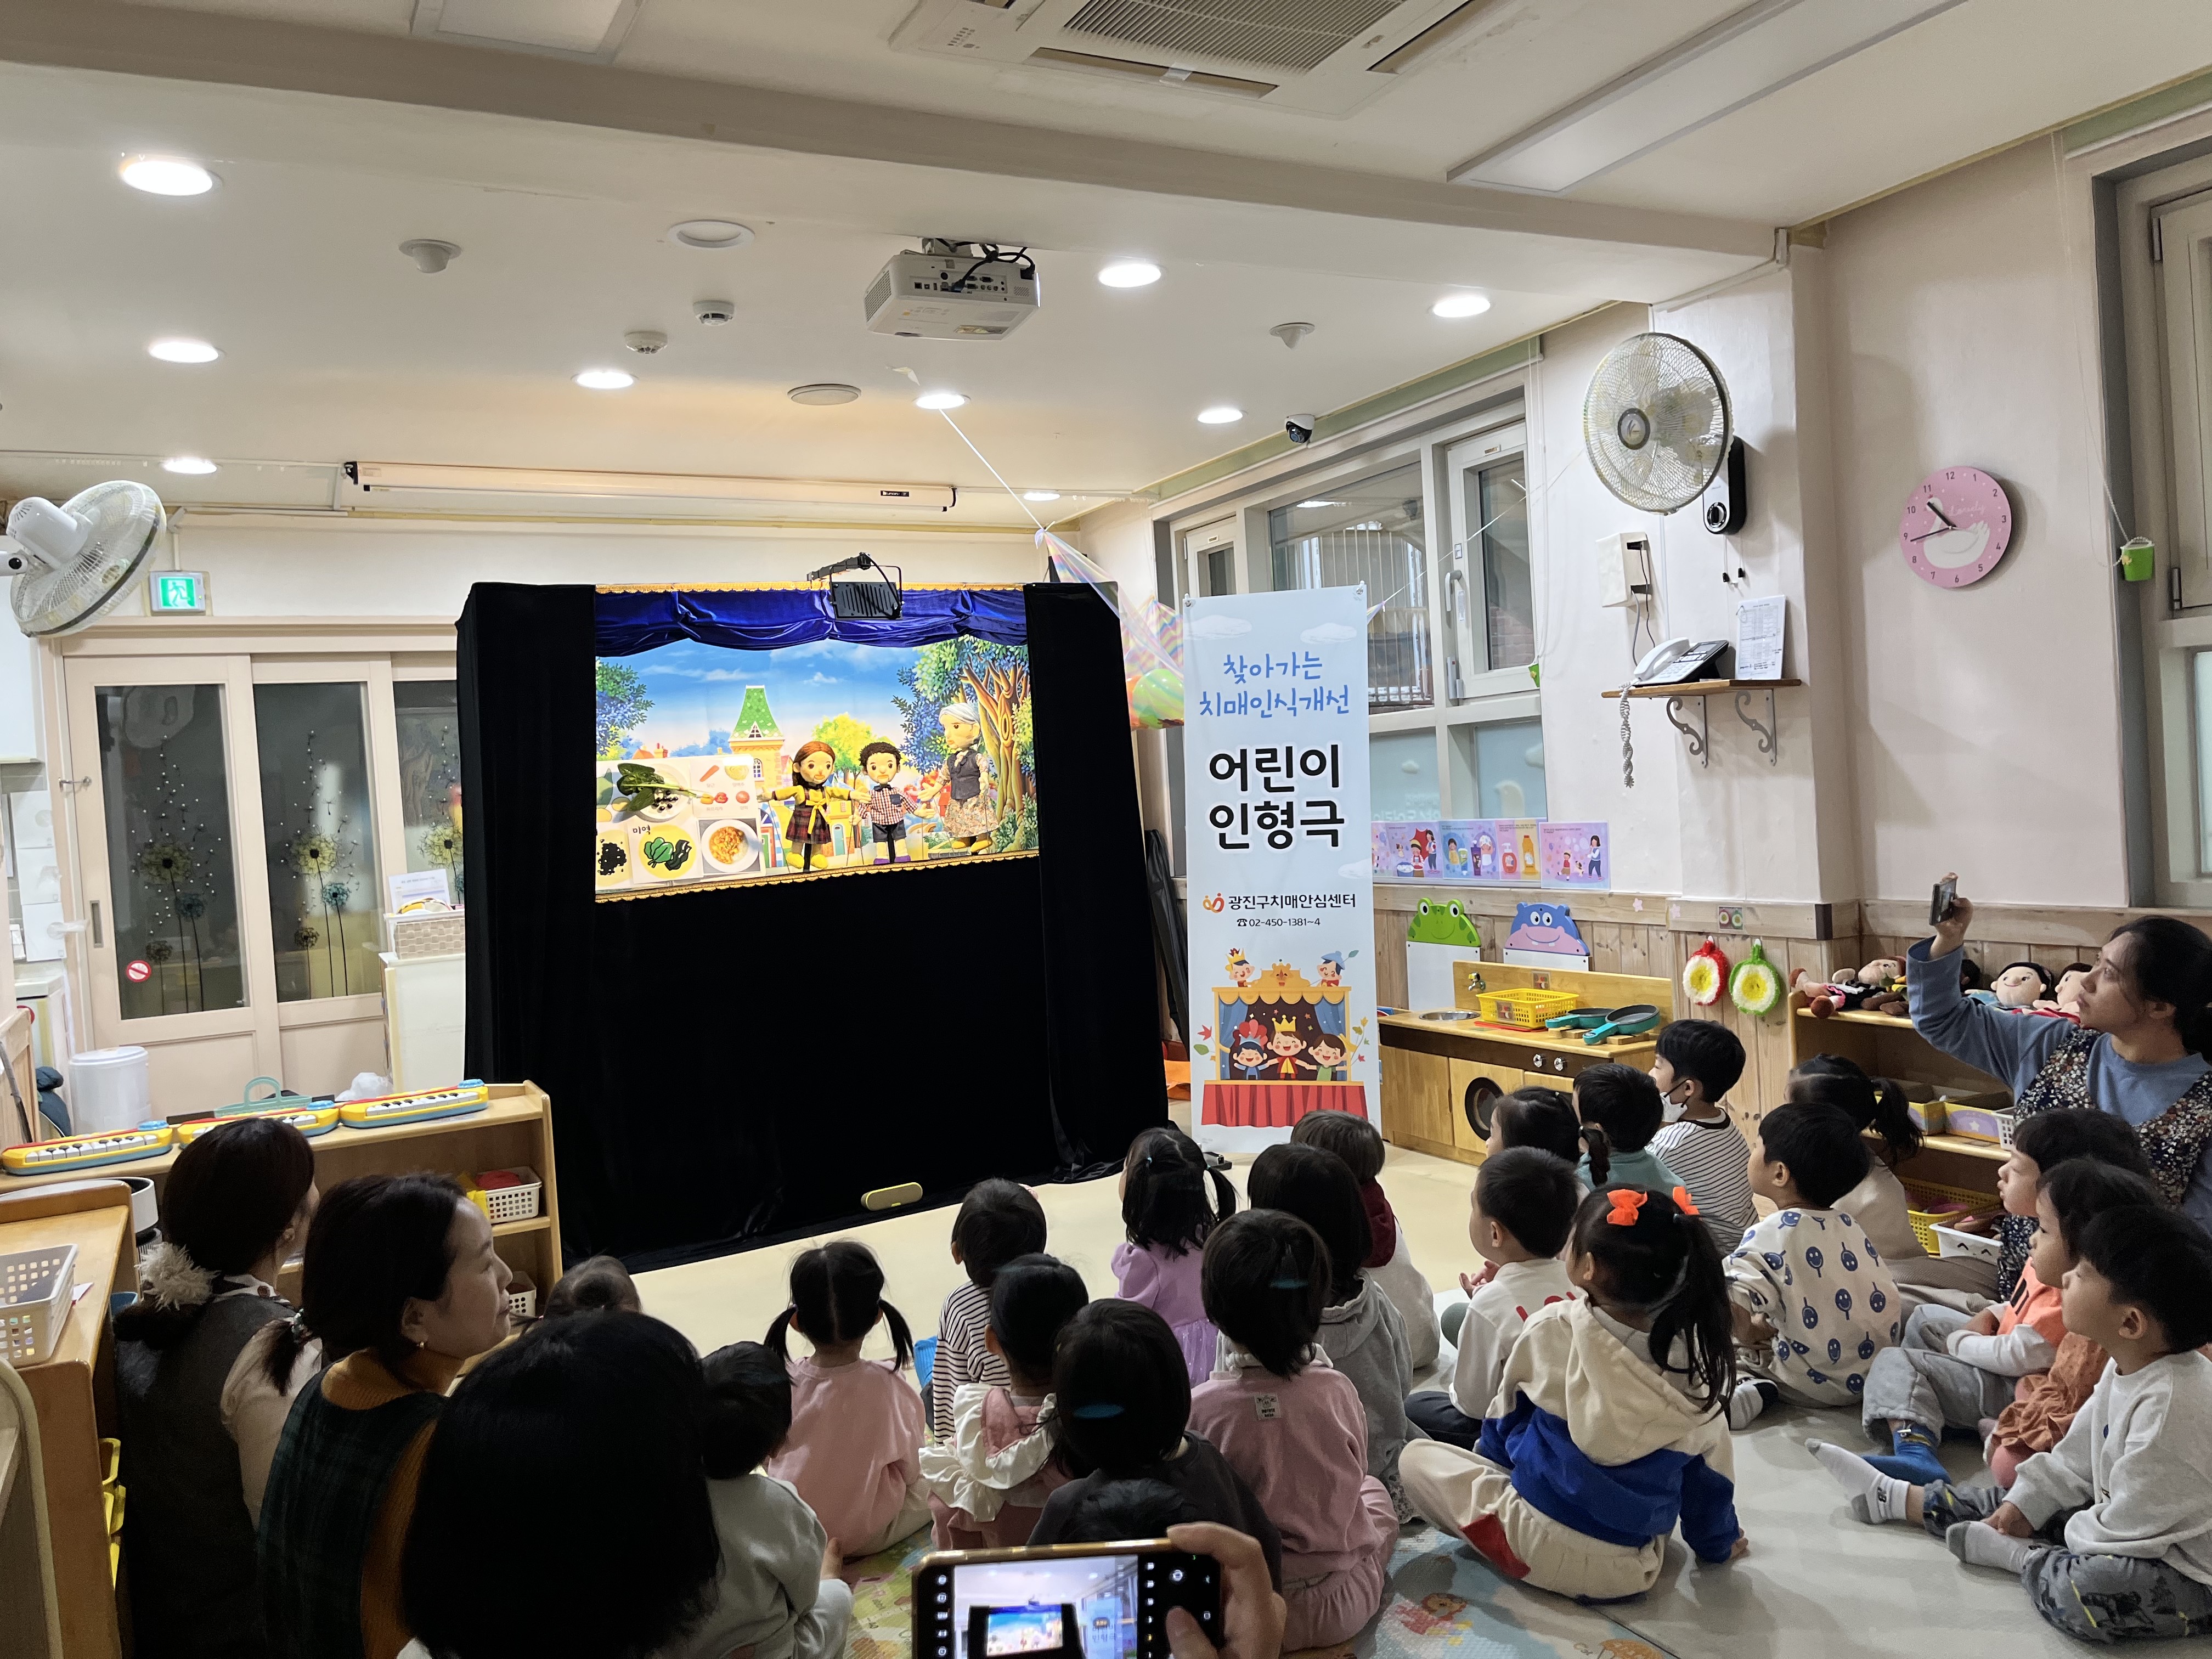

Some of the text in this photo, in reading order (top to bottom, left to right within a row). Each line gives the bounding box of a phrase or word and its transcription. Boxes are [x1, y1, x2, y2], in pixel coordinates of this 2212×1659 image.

[1946, 471, 1955, 480] 12
[1973, 473, 1977, 482] 1
[1923, 484, 1932, 493] 11
[1993, 488, 1998, 497] 2
[1907, 506, 1916, 514] 10
[2001, 515, 2007, 523] 3
[1904, 532, 1908, 540] 9
[1978, 563, 1983, 572] 5
[1931, 571, 1936, 580] 7
[1955, 575, 1960, 583] 6
[1223, 651, 1322, 684] 찾아가는
[1200, 684, 1349, 718] 치매인식개선
[1209, 744, 1339, 793] 어린이
[1209, 800, 1345, 849] 인형극
[633, 825, 651, 835] 미역
[1228, 893, 1356, 911] 광진구치매안심센터
